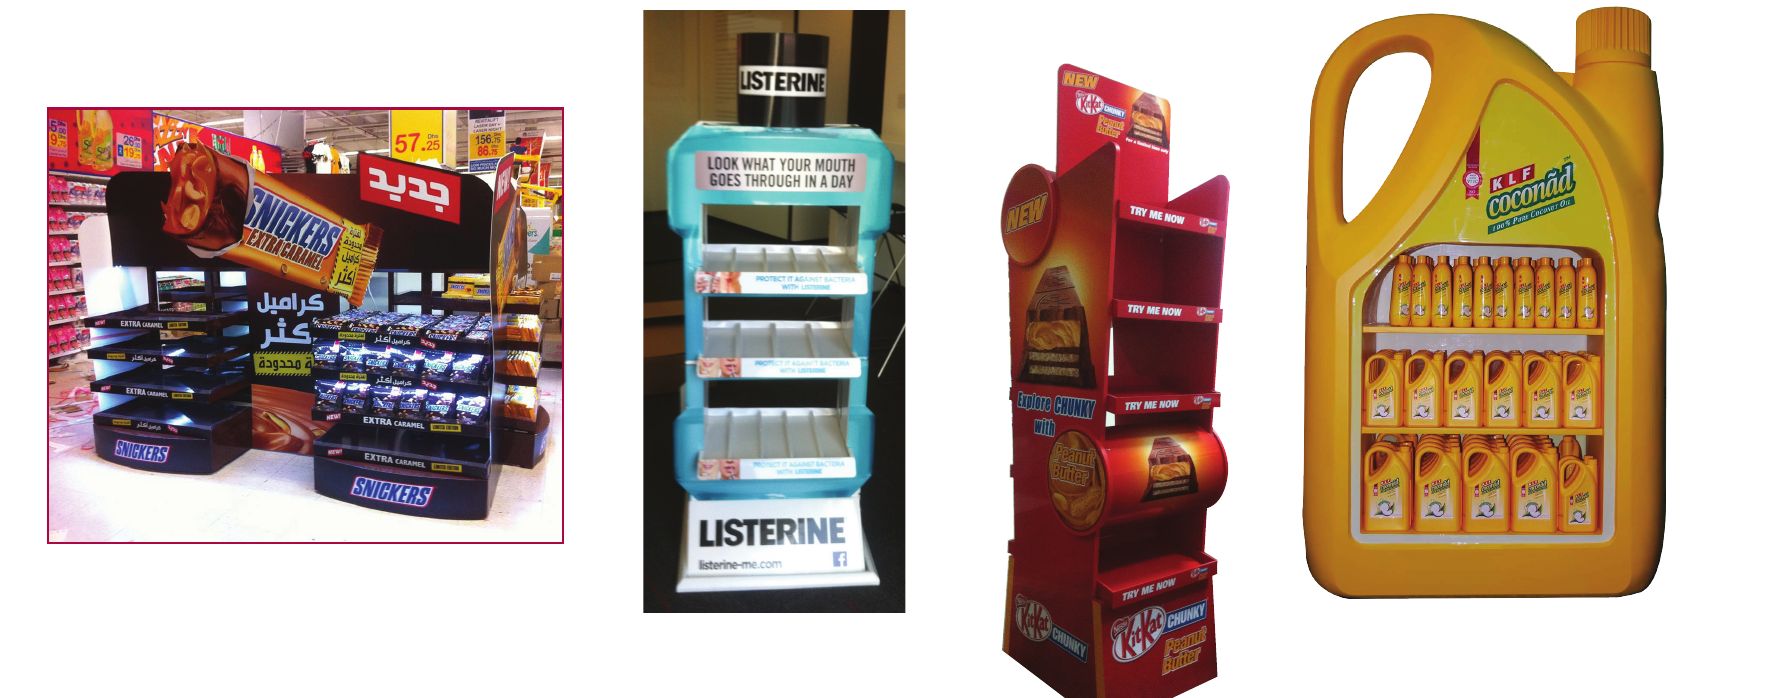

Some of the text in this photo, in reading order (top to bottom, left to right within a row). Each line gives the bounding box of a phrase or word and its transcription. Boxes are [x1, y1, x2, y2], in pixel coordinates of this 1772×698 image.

[741, 71, 825, 92] LISTERINE
[1062, 71, 1098, 88] NEW
[1079, 95, 1102, 113] KitKat
[1104, 106, 1125, 117] CHUNKY
[707, 156, 856, 173] LOOK WHAT YOUR MOUTH
[368, 167, 449, 213] جديد
[709, 173, 855, 189] GOES THROUGH IN A DAY
[244, 187, 341, 256] SNICKERS
[1005, 193, 1048, 233] NEW
[1130, 205, 1185, 225] TRY ME NOW
[1492, 220, 1511, 232] 100%
[246, 228, 324, 270] EXTRA CARAMEL
[756, 275, 785, 283] PROTECT
[256, 292, 325, 316] كراميل
[1128, 304, 1182, 317] TRY ME NOW
[120, 320, 141, 328] EXTRA
[374, 334, 391, 344] أكثر
[258, 356, 302, 371] محدودة
[376, 376, 393, 384] أكثر
[126, 387, 146, 396] EXTRA
[1017, 391, 1096, 419] Explore CHUNKY
[1125, 400, 1179, 411] TRY ME NOW
[363, 416, 425, 430] EXTRA CARAMEL
[1034, 418, 1055, 437] with
[116, 440, 168, 462] SNICKERS
[364, 452, 426, 468] EXTRA CARAMEL
[1053, 442, 1097, 468] Peanut
[1051, 460, 1089, 487] Butter
[352, 477, 432, 506] SNICKERS
[699, 517, 846, 547] LISTERINE
[699, 560, 782, 570] listerine-me.com
[1122, 577, 1177, 601] TRY ME NOW
[1020, 602, 1050, 640] KitKat
[1167, 601, 1206, 629] CHUNKY
[1052, 626, 1086, 658] CHUNKY
[1120, 608, 1163, 659] KitKat
[1163, 625, 1207, 658] Peanut
[1161, 646, 1202, 677] Butter
